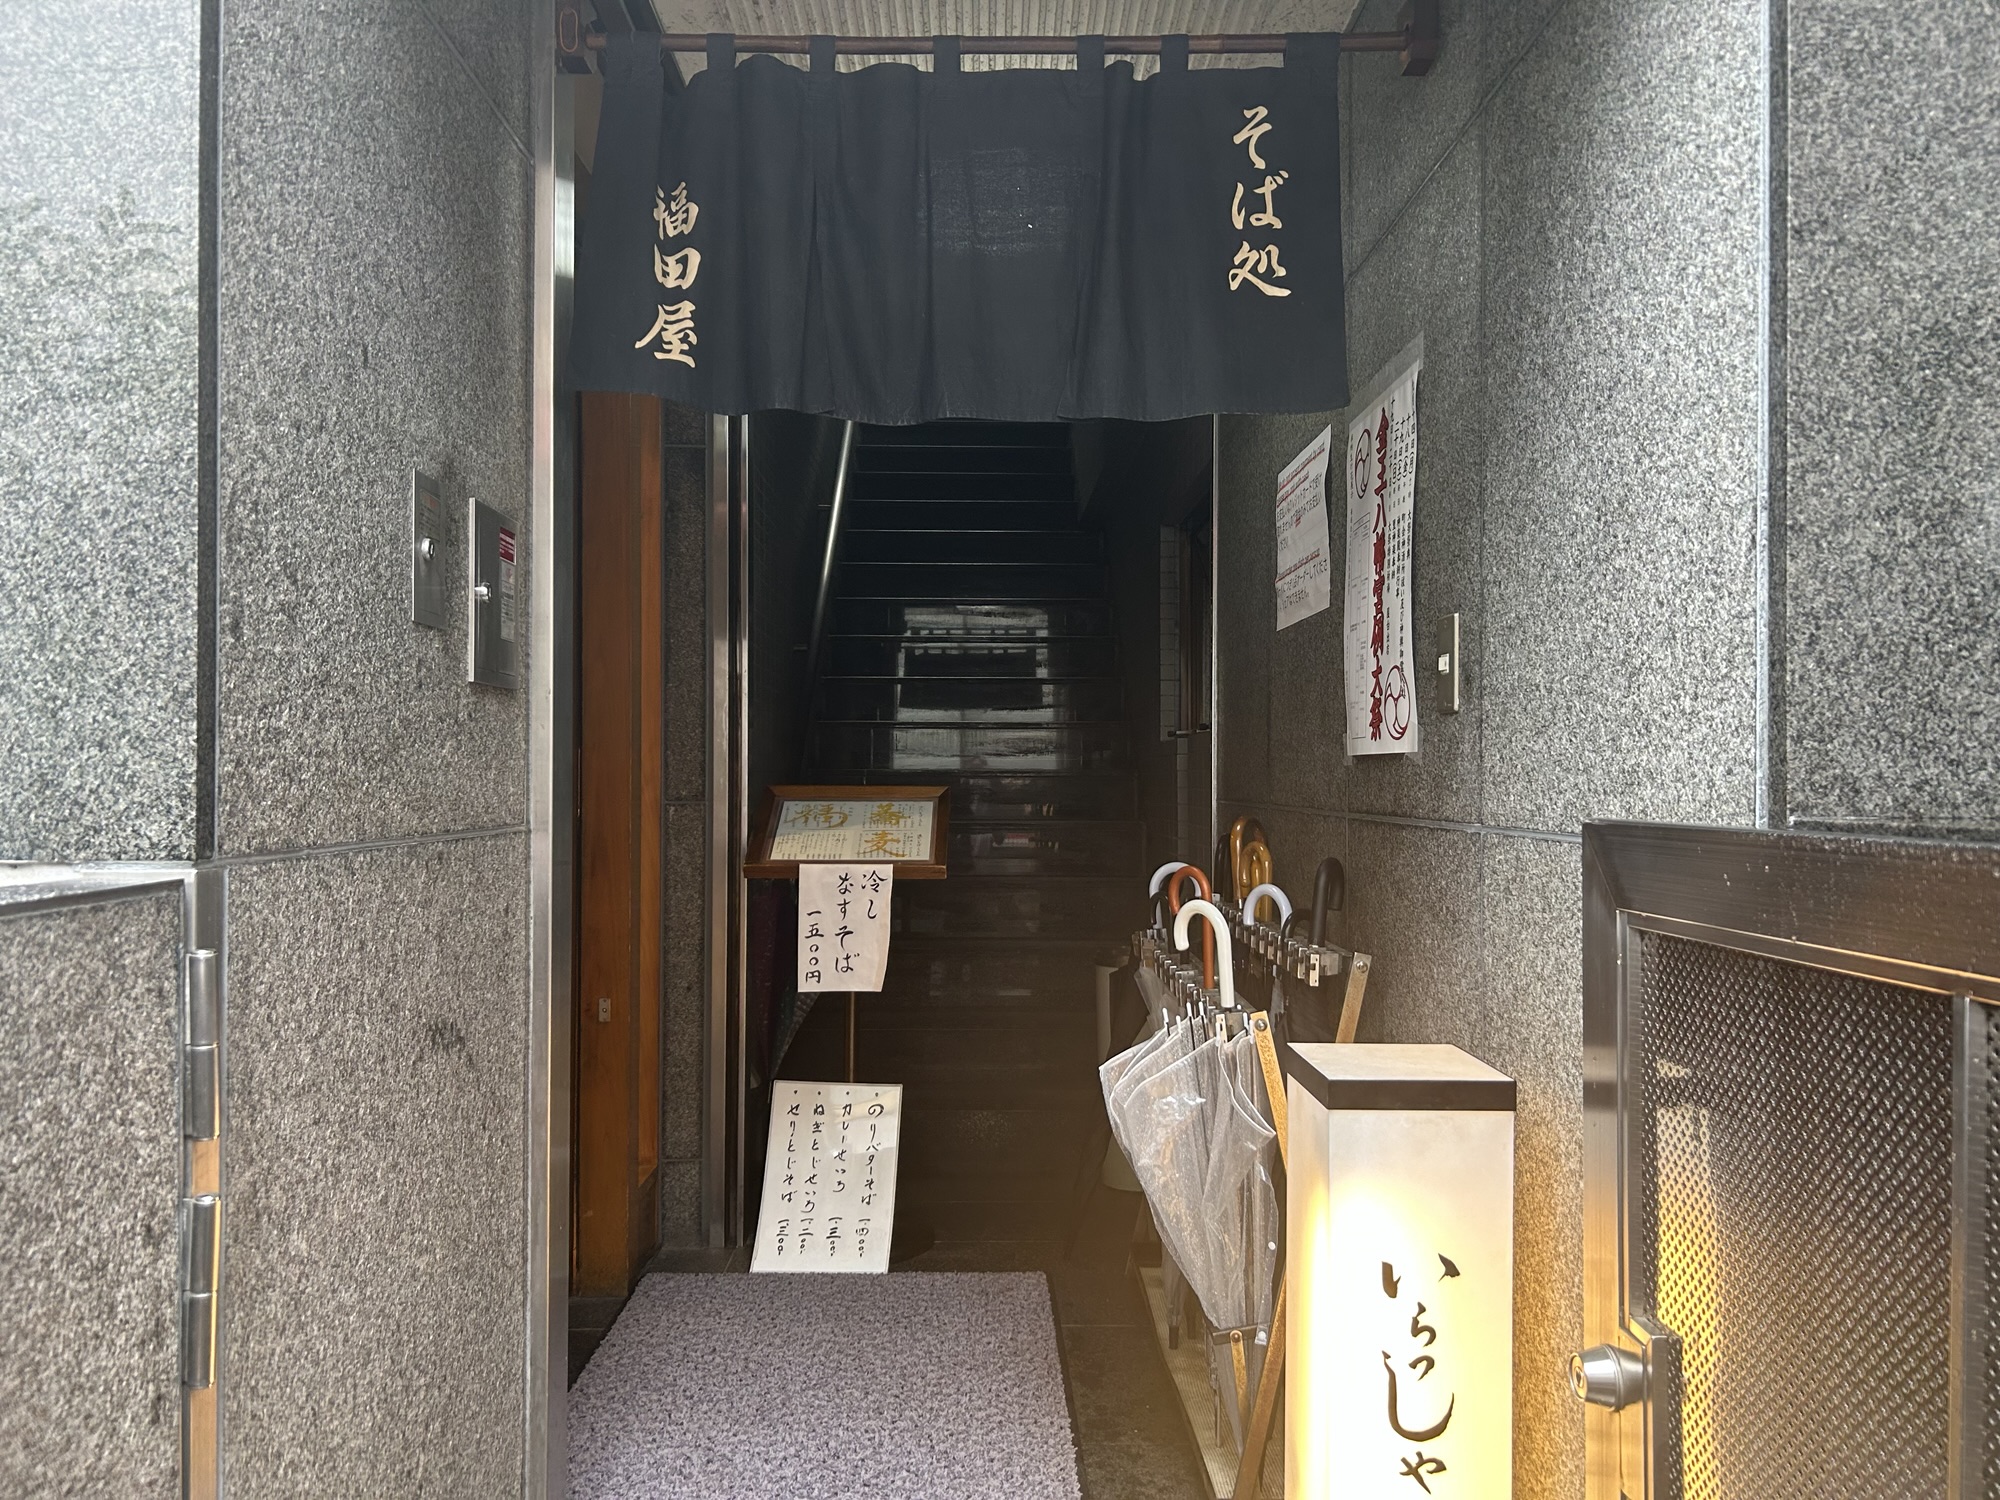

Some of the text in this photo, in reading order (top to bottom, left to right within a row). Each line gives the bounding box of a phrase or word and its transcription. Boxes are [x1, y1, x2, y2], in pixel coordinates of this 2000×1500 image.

[1227, 105, 1292, 298] そば処
[634, 181, 701, 368] 福田屋
[835, 872, 860, 973] なすそば
[861, 870, 888, 919] 冷し
